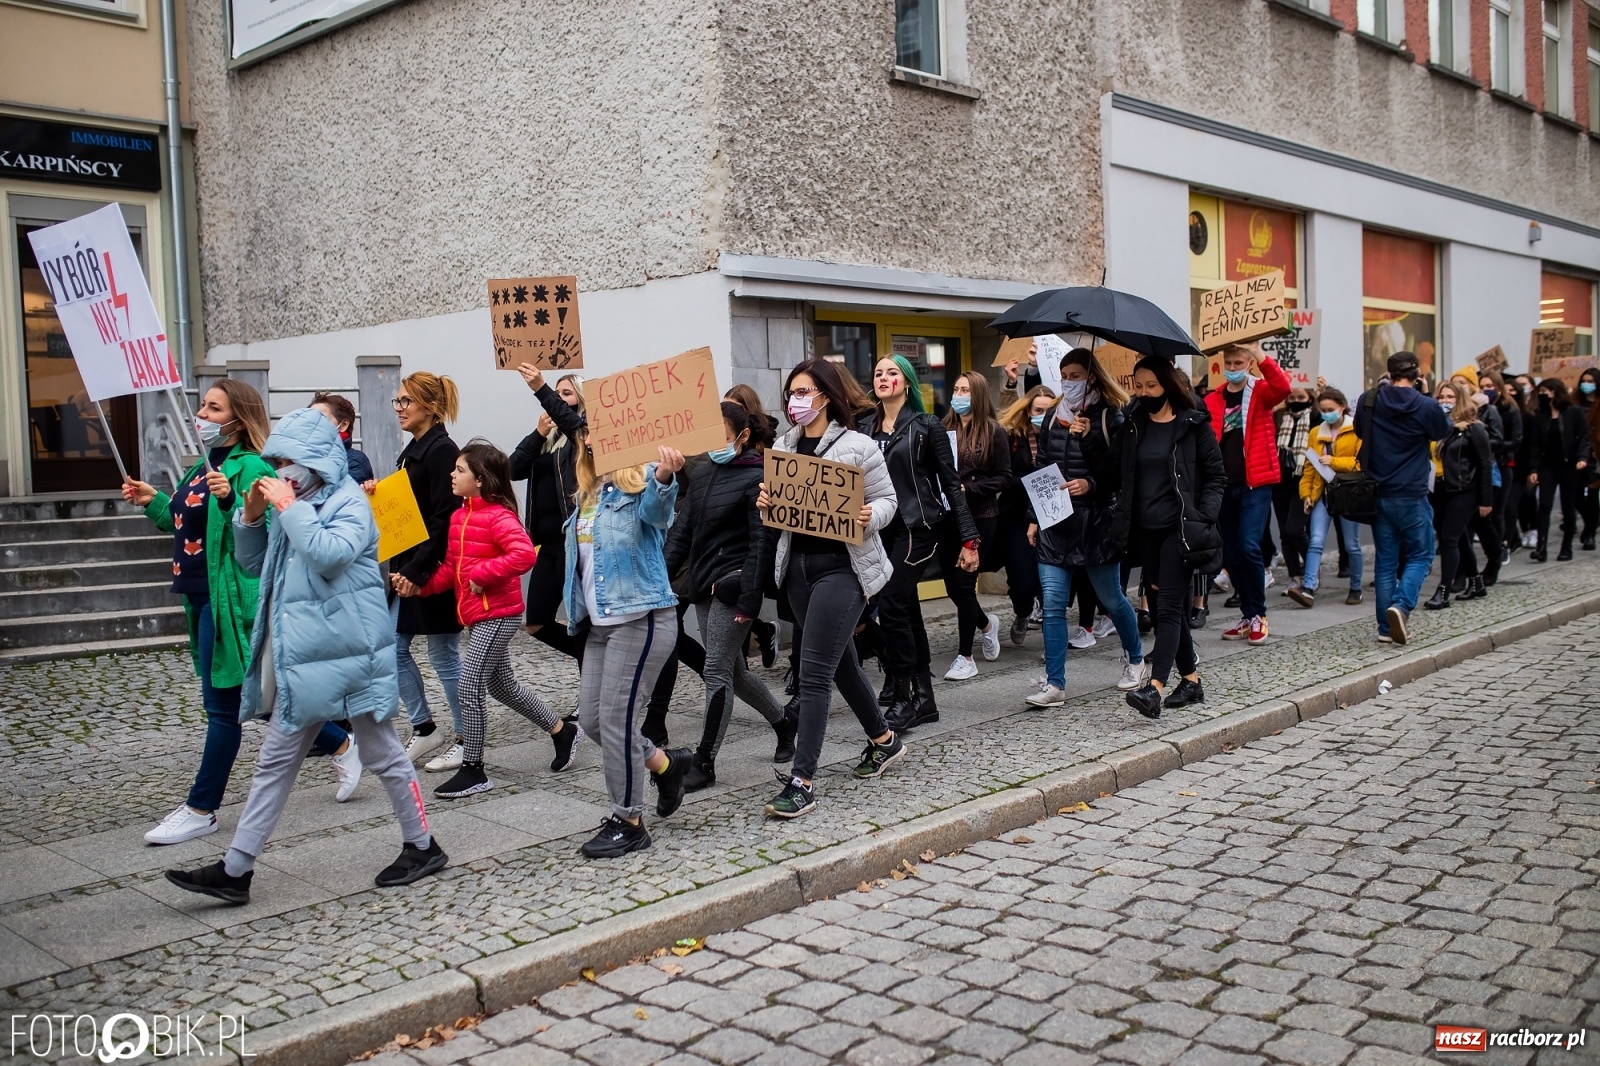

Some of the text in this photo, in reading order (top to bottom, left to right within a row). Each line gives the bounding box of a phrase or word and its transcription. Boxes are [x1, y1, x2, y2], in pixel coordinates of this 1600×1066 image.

[71, 131, 152, 151] IMMOBILIEN
[0, 150, 123, 178] KARPIŃSCY
[1205, 278, 1276, 308] REAL MEN
[1217, 297, 1255, 321] ARE
[89, 298, 122, 345] NIE
[1202, 305, 1284, 342] FEMINISTS
[599, 361, 683, 409] GODEK
[598, 409, 695, 455] THE IMPOSTOR
[608, 402, 647, 428] WAS
[771, 456, 860, 491] TO JEST
[770, 481, 851, 515] WOJNA Z
[767, 504, 855, 538] KOBIETAMI
